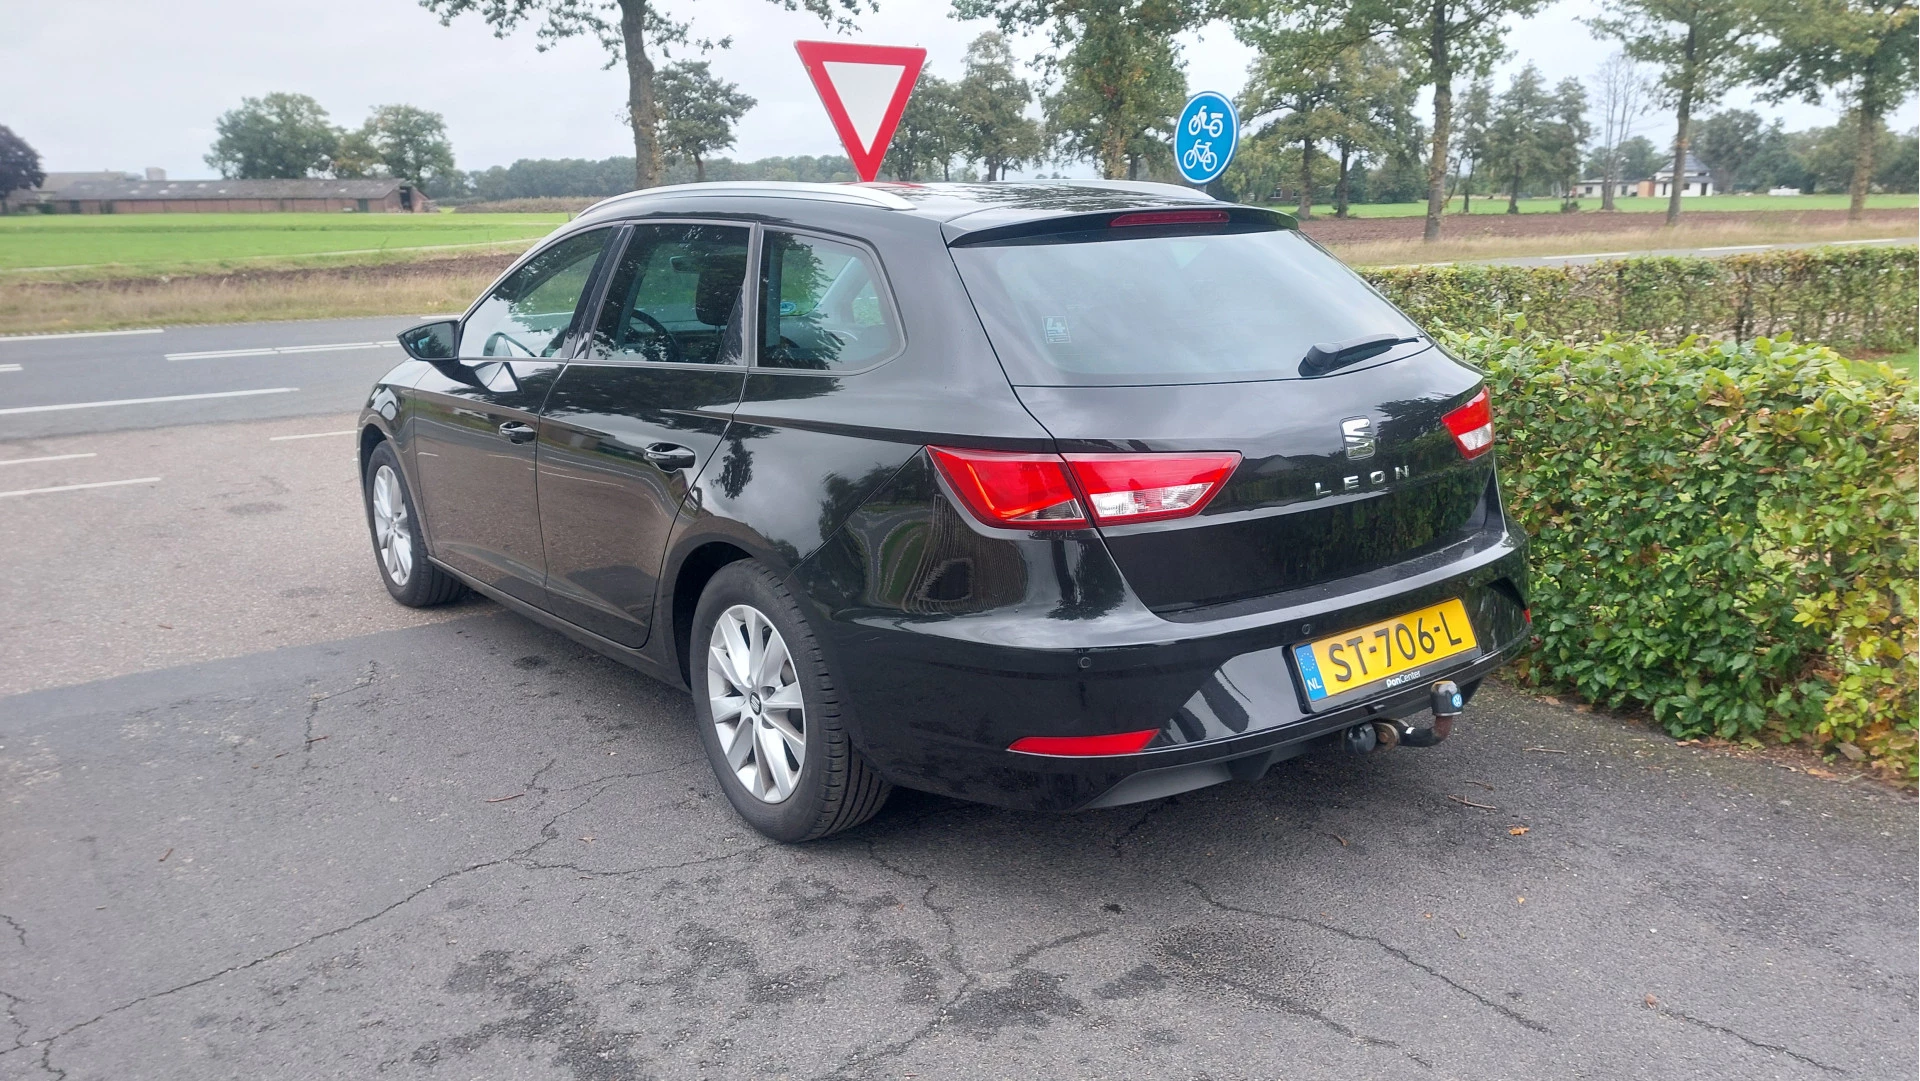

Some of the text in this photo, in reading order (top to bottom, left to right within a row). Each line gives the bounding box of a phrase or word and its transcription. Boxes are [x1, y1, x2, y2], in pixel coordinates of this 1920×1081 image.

[1315, 465, 1410, 496] LEON
[1328, 611, 1462, 682] ST-706-L
[1306, 677, 1323, 691] NL
